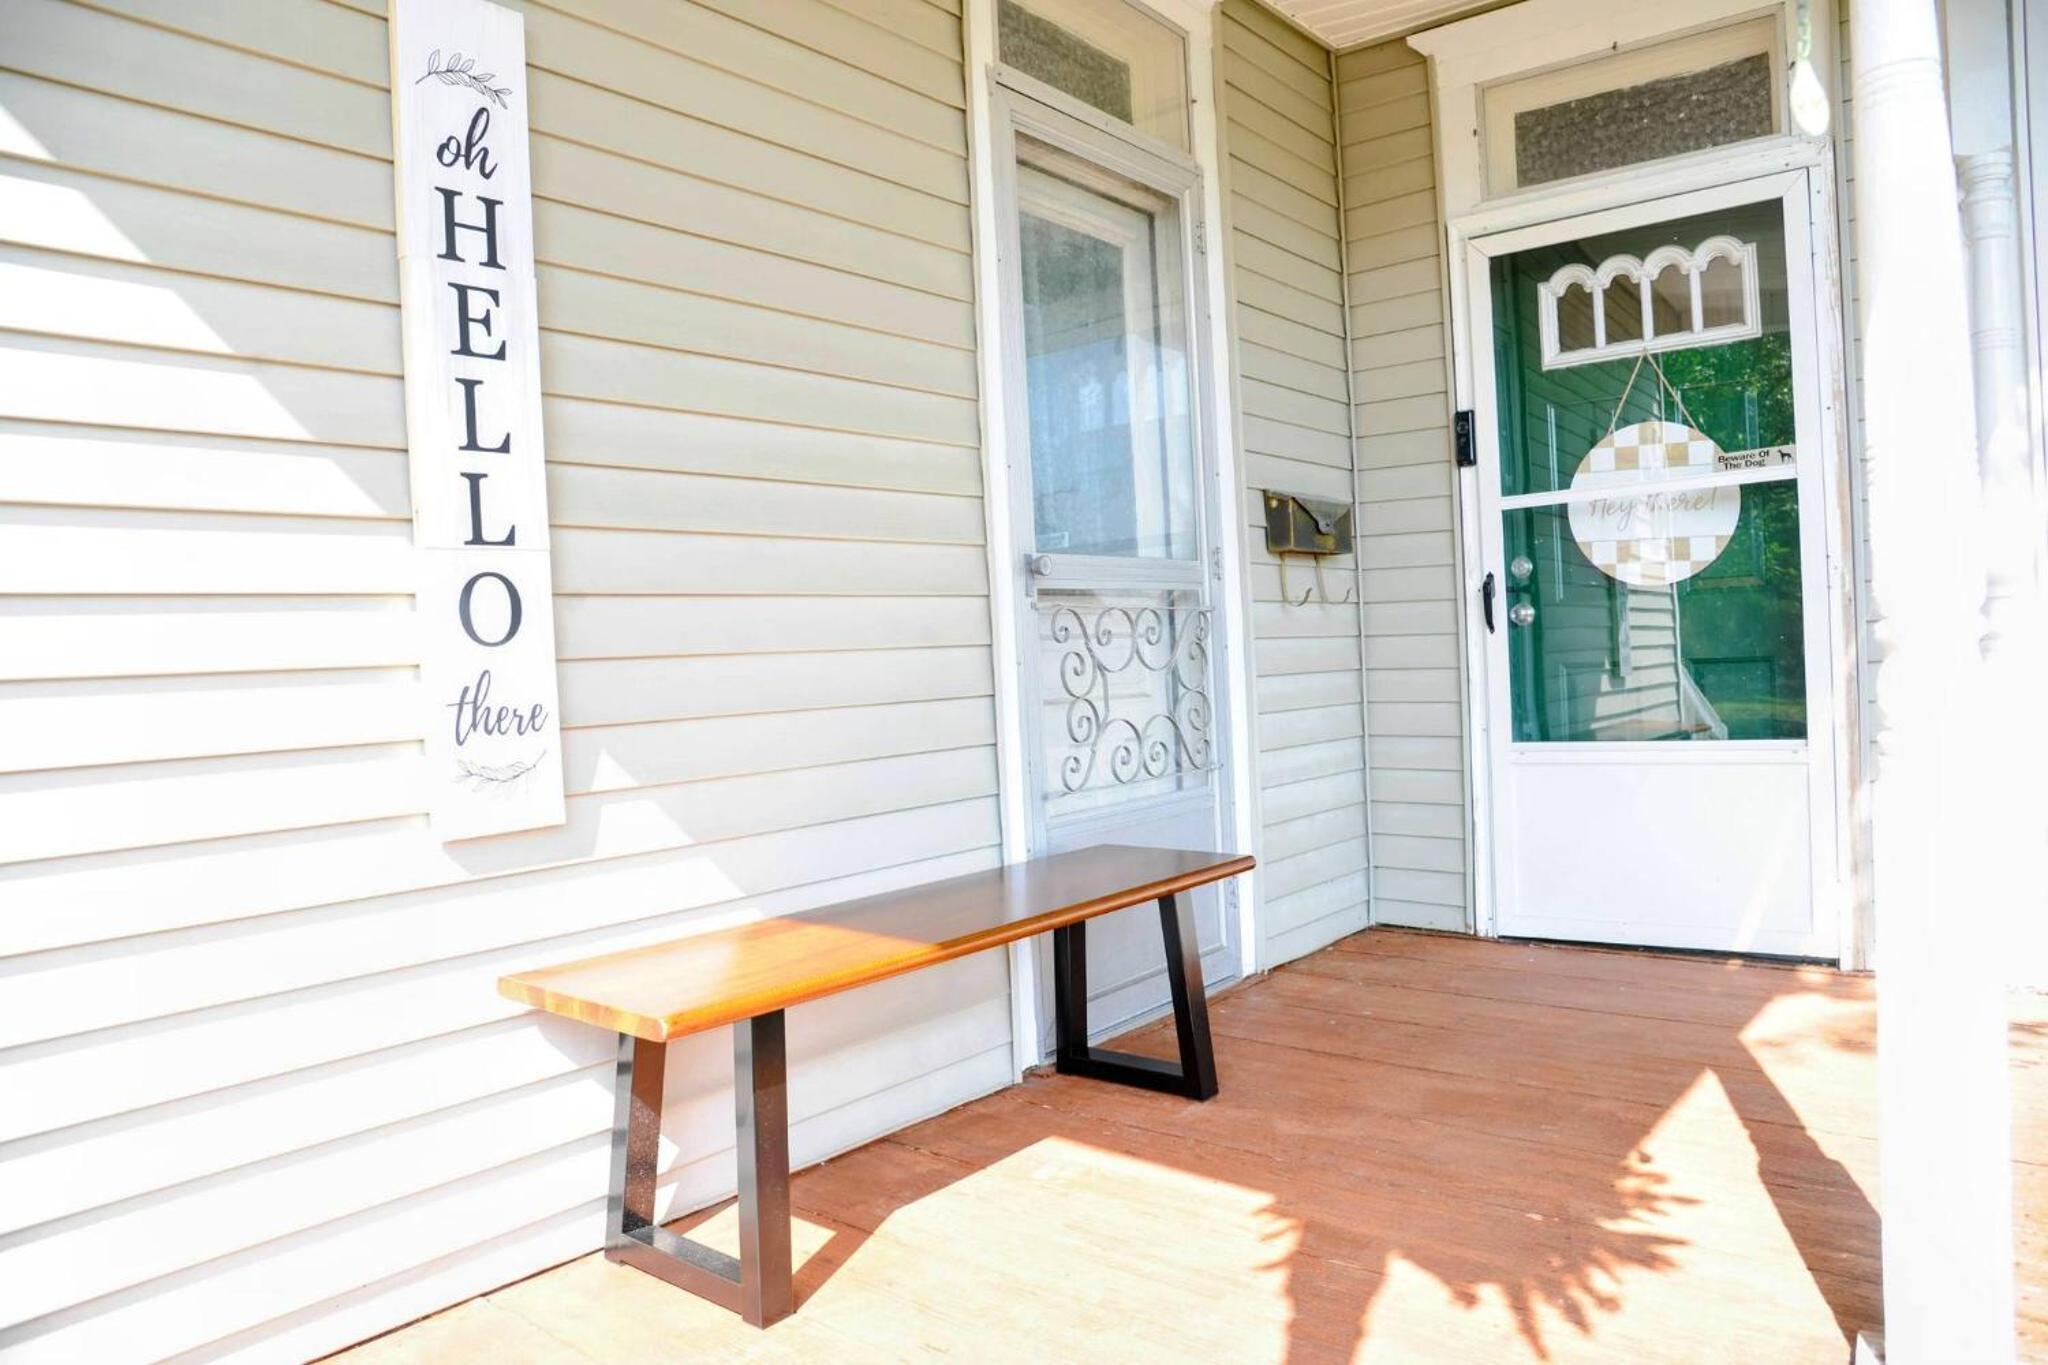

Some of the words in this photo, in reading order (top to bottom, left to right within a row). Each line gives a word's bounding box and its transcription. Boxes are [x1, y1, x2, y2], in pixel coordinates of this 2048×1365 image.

[436, 107, 498, 180] oh
[434, 186, 521, 648] HELLO
[1718, 453, 1756, 464] Beware
[1759, 450, 1769, 458] Of
[1724, 461, 1742, 470] The
[1745, 459, 1766, 468] Dog!
[446, 669, 549, 747] there
